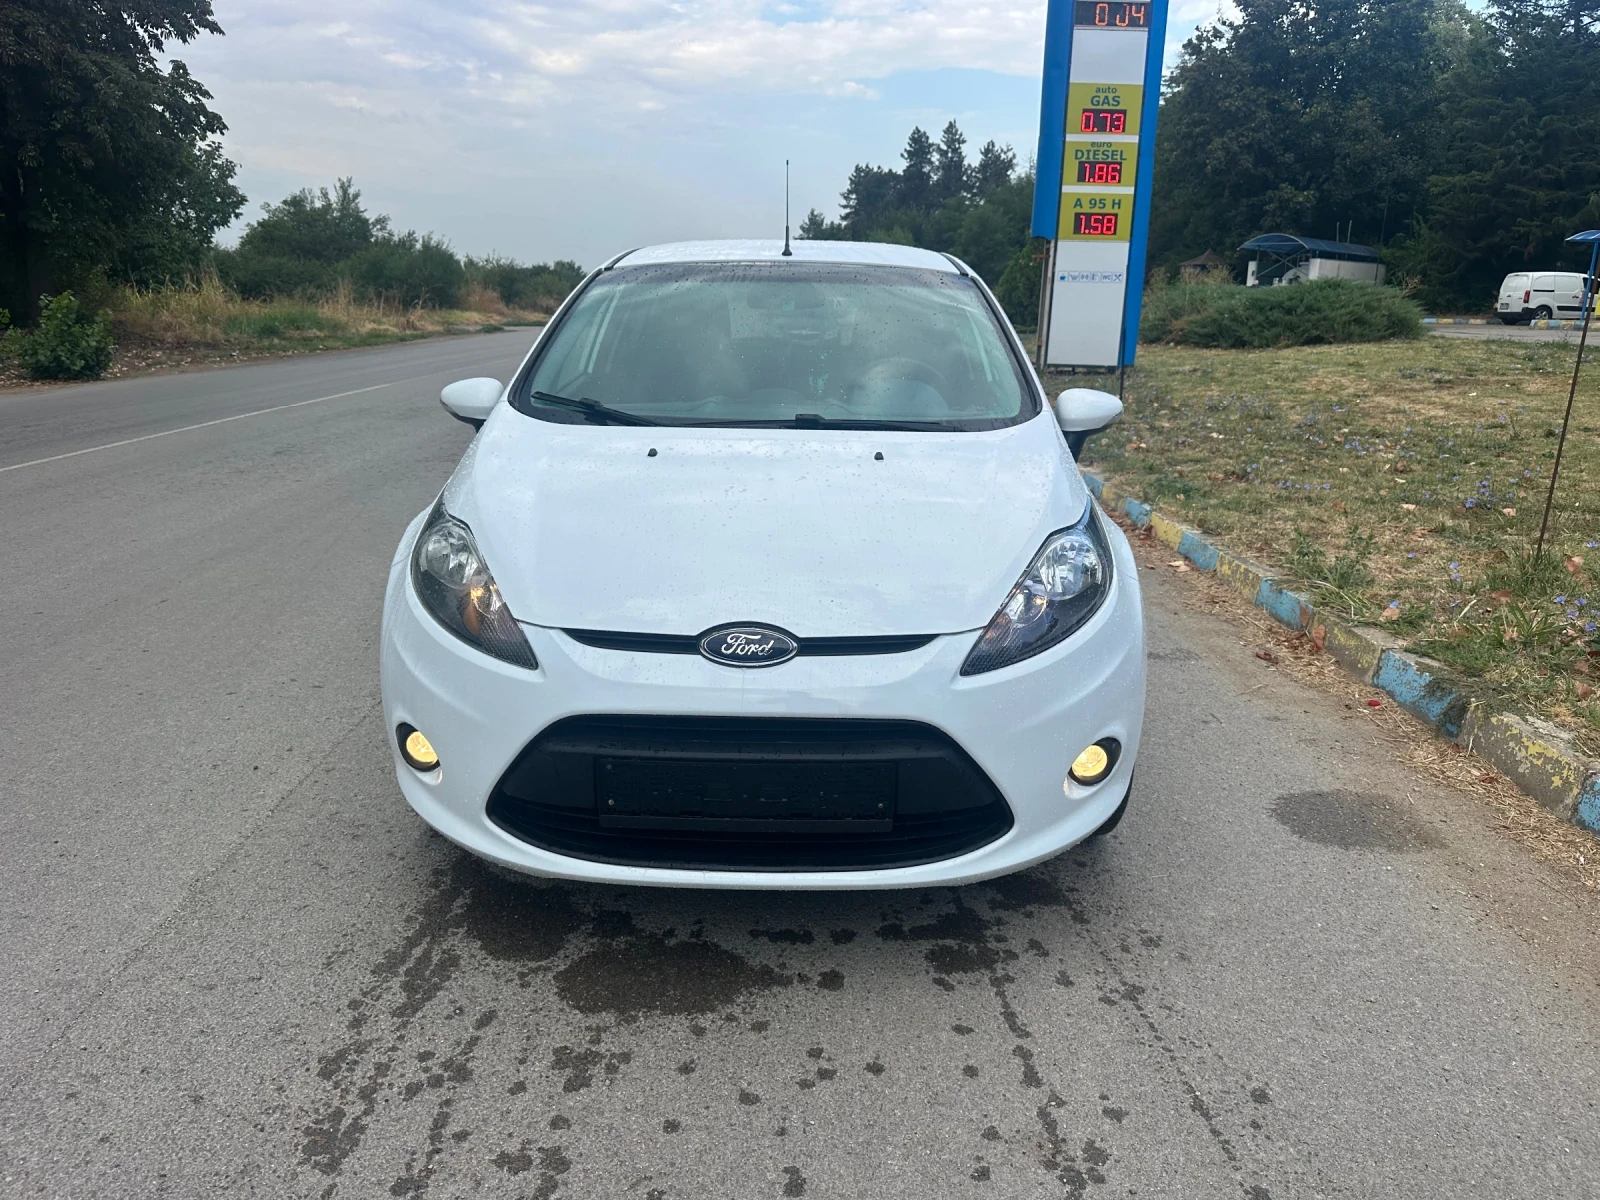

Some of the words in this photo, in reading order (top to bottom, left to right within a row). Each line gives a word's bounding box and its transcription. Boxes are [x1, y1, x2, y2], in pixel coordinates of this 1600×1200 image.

[1095, 86, 1117, 94] auto
[1090, 95, 1121, 107] GAS
[1081, 111, 1125, 133] 0.73
[1074, 149, 1127, 161] DIESEL
[1084, 163, 1120, 184] 1.86
[1073, 198, 1083, 209] A
[1089, 198, 1107, 209] 95
[1112, 199, 1122, 210] H
[1080, 214, 1116, 235] 1.58
[721, 633, 775, 656] Ford
